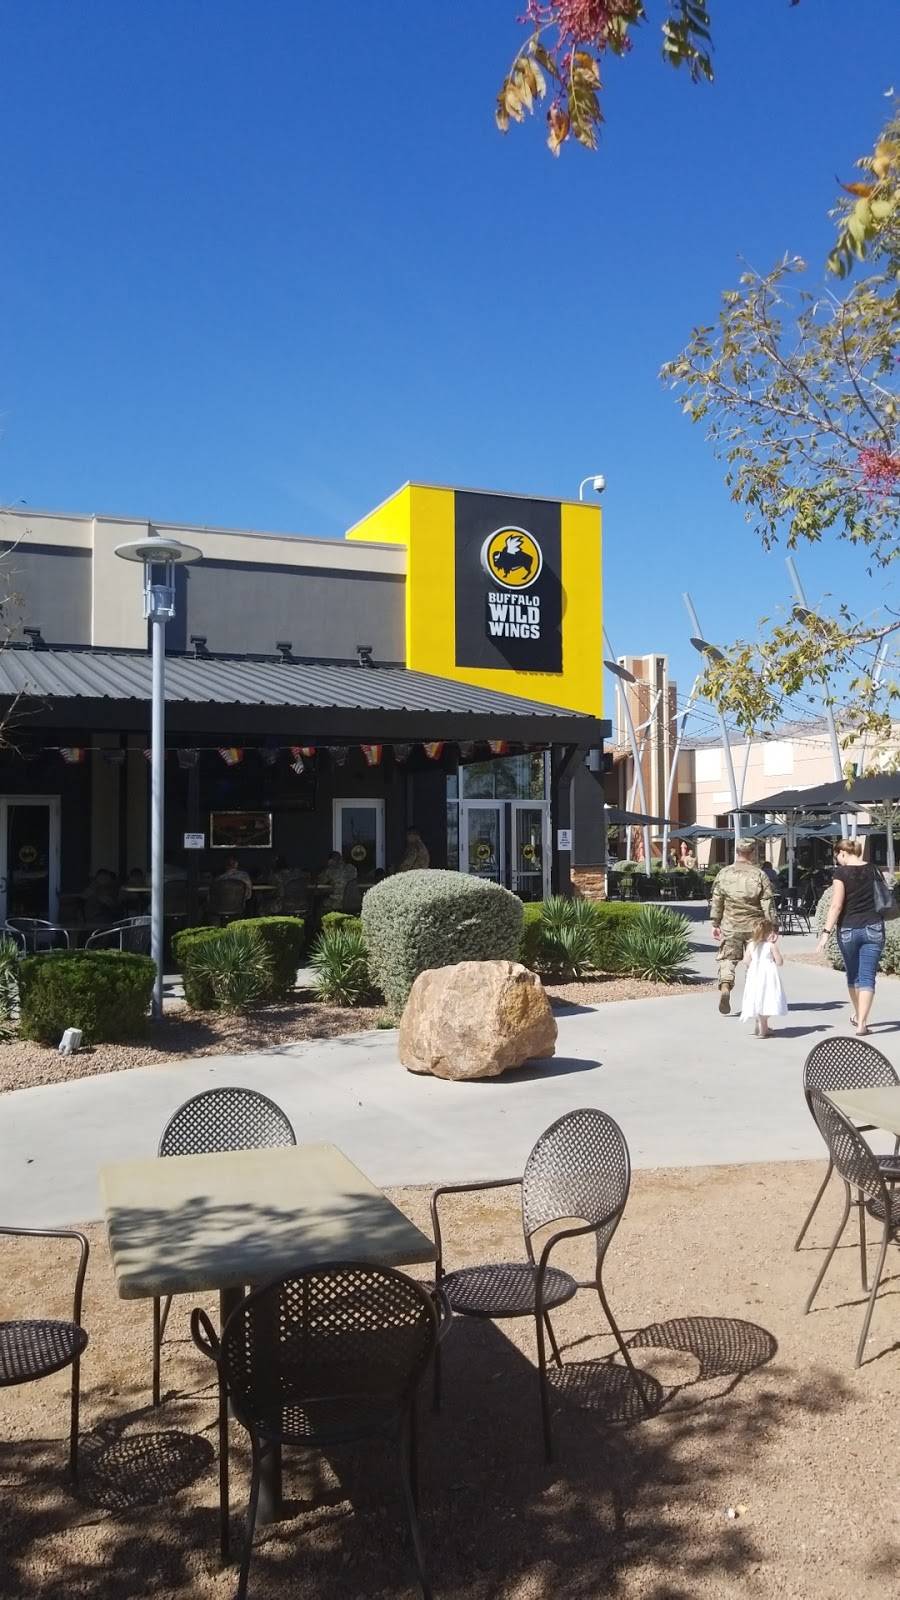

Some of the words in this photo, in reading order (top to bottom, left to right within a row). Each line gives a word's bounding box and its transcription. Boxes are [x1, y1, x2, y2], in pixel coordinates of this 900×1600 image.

[488, 592, 540, 607] BUFFALO
[488, 603, 540, 624] WILD
[488, 621, 540, 639] WINGS
